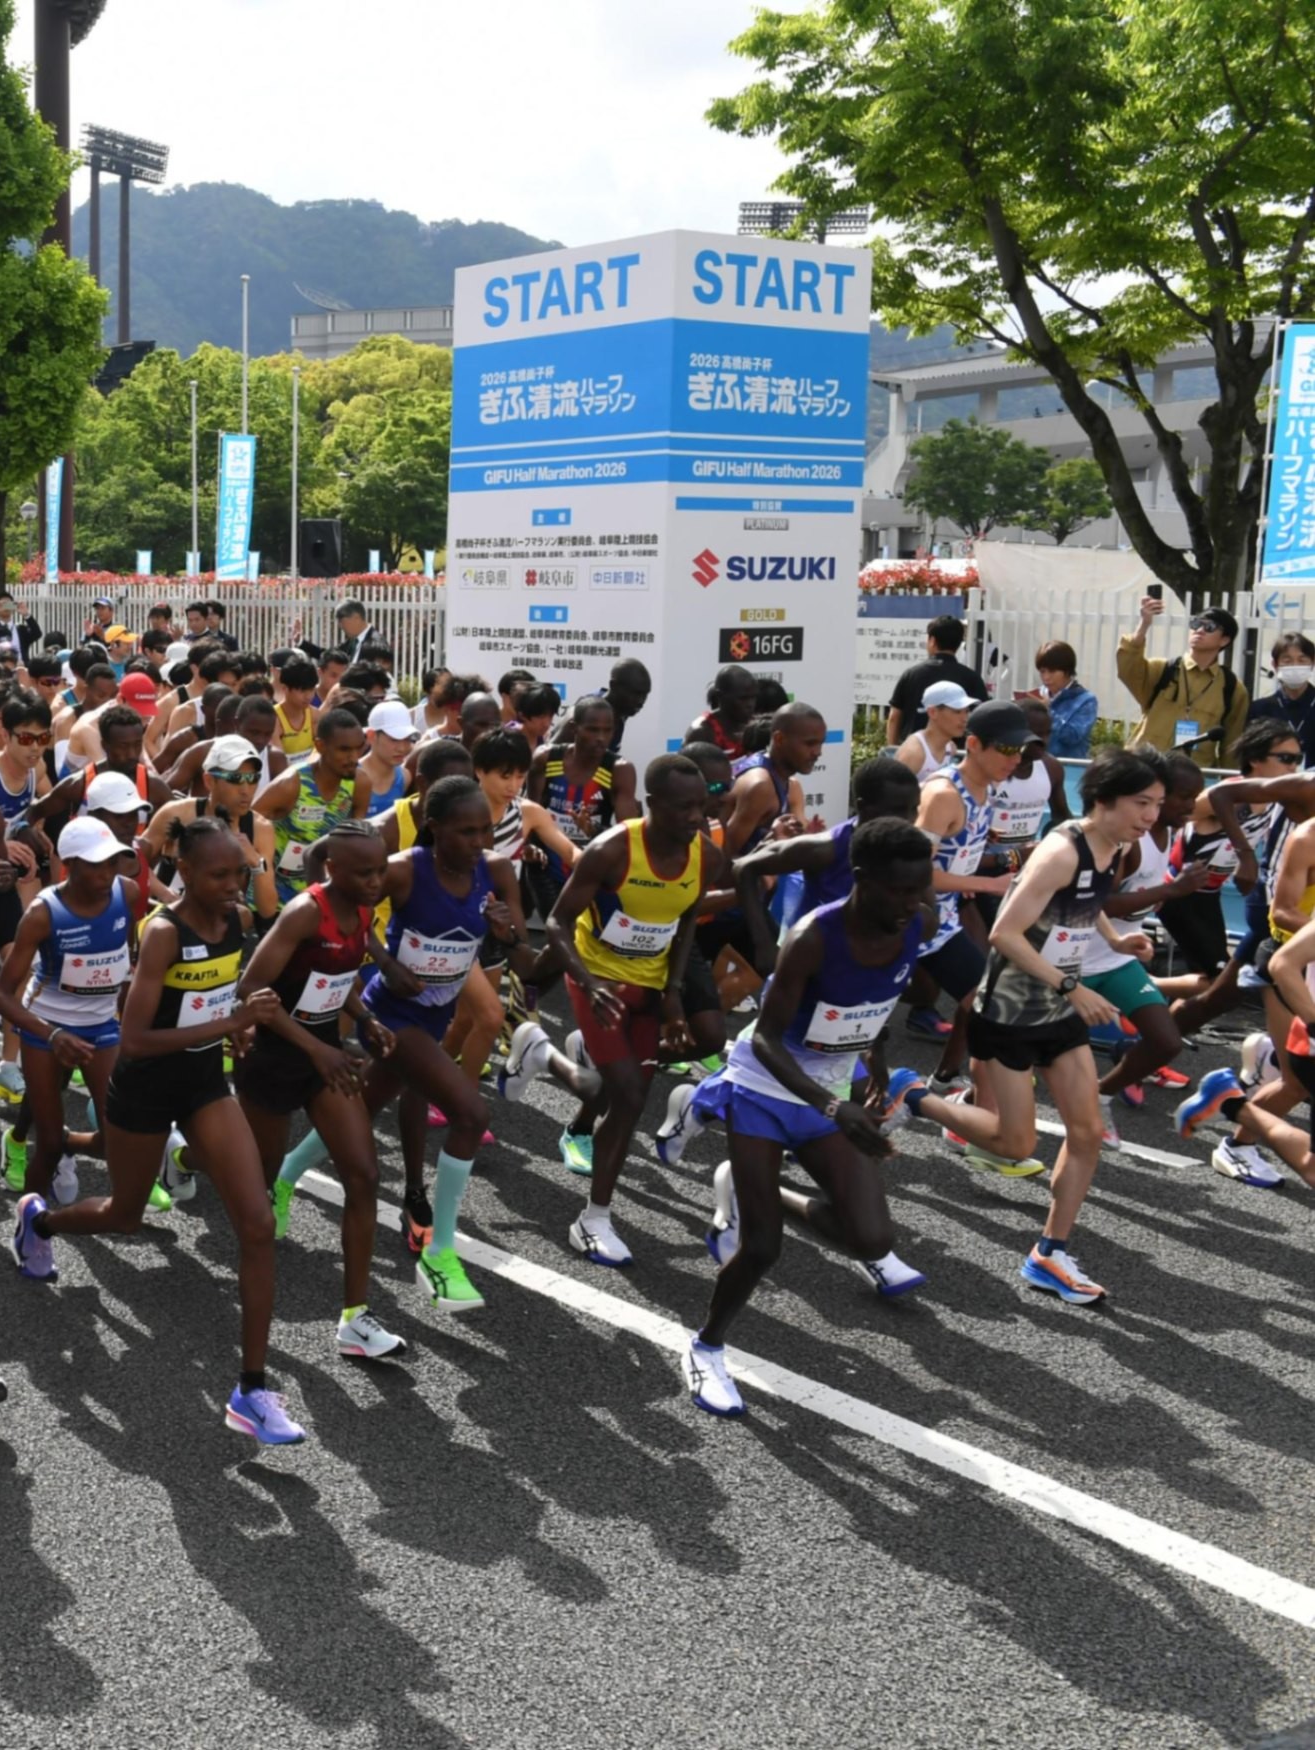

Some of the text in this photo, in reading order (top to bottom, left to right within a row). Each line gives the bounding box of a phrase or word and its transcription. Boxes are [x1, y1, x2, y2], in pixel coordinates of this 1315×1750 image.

[483, 253, 640, 328] START
[692, 249, 855, 316] START
[689, 352, 773, 371] 2026 高橋尚子杯
[480, 365, 555, 387] 2026 高橋尚子杯
[580, 374, 623, 397] ハーフ
[687, 371, 797, 416] ぎふ清流
[797, 376, 840, 398] ハーフ
[478, 379, 580, 425] ぎふ清流
[580, 393, 636, 416] マラソン
[798, 396, 851, 419] マラソン
[483, 461, 627, 485] GIFU Half Marathon 2026
[692, 460, 842, 480] GIFU Half Marathon 2026
[1275, 420, 1307, 551] ハーフマラソン
[746, 519, 787, 530] PLATINUM
[539, 569, 574, 586] 岐阜市
[593, 571, 646, 585] 中日新聞社
[726, 556, 836, 581] SUZUKI
[747, 609, 777, 621] GOLD
[753, 634, 793, 655] 16FG
[627, 878, 666, 888] SUZUKI
[56, 924, 92, 936] Panasonic
[631, 935, 655, 944] 102
[423, 943, 474, 954] SUZUKI
[428, 956, 448, 967] 22
[92, 968, 110, 980] 24
[175, 969, 219, 981] KRAFTIA
[855, 1023, 862, 1032] 1
